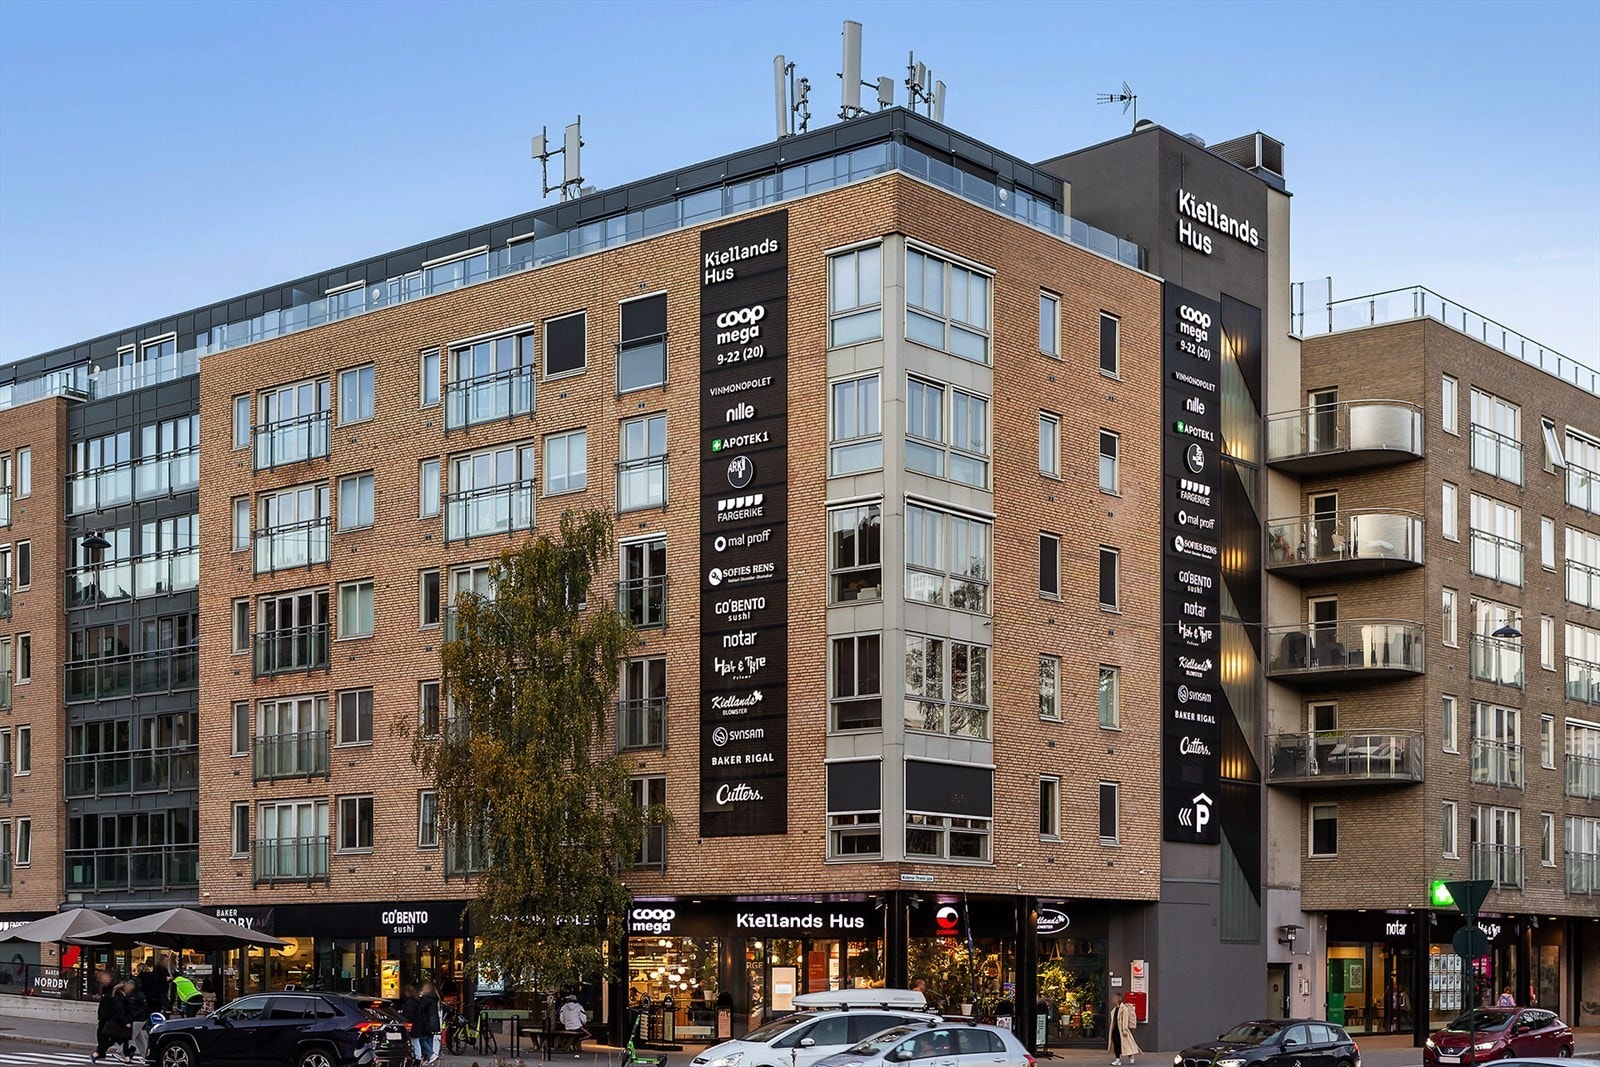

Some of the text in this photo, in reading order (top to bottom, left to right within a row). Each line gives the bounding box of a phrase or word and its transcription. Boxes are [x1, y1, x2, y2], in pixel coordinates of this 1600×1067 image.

[1179, 188, 1259, 247] Kiellands
[1179, 218, 1212, 255] Hus
[705, 238, 778, 268] Kiellands
[705, 267, 734, 285] Hus
[717, 305, 765, 328] coop
[1180, 304, 1211, 329] coop
[717, 325, 759, 345] mega
[1180, 321, 1208, 343] mega
[717, 345, 764, 365] 9-22 (20)
[1180, 340, 1211, 361] 9-22 (20)
[710, 376, 772, 396] VINMONOPOLET
[1175, 371, 1216, 392] VINMONOPOLET
[726, 402, 754, 422] nille
[1186, 397, 1205, 415] nille
[1180, 490, 1210, 506] FARGERIKE
[718, 507, 763, 522] FARGERIKE
[1187, 515, 1215, 529] mal proff
[728, 529, 771, 547] mal proff
[1184, 540, 1203, 553] SOFIES
[1203, 544, 1217, 555] RENS
[723, 565, 751, 578] SOFIES
[752, 562, 775, 574] RENS
[1187, 585, 1203, 594] sushi
[728, 611, 751, 622] sushi
[1184, 601, 1206, 618] notar
[723, 630, 757, 648] notar
[711, 694, 757, 709] Kiellands
[722, 707, 748, 716] BLOMSTER
[1174, 710, 1216, 724] BAKER RIGAL
[729, 728, 764, 741] SYNSAM
[1180, 736, 1211, 756] Cutters.
[712, 753, 774, 766] BAKER RIGAL
[716, 783, 764, 805] Cutters.
[1196, 803, 1210, 833] P
[216, 909, 238, 917] BAKER
[632, 909, 675, 922] coop
[736, 913, 865, 928] Kiellands Hus
[393, 925, 414, 933] sushi
[632, 922, 671, 934] mega
[1386, 920, 1407, 936] notar
[34, 977, 69, 989] NORDBY
